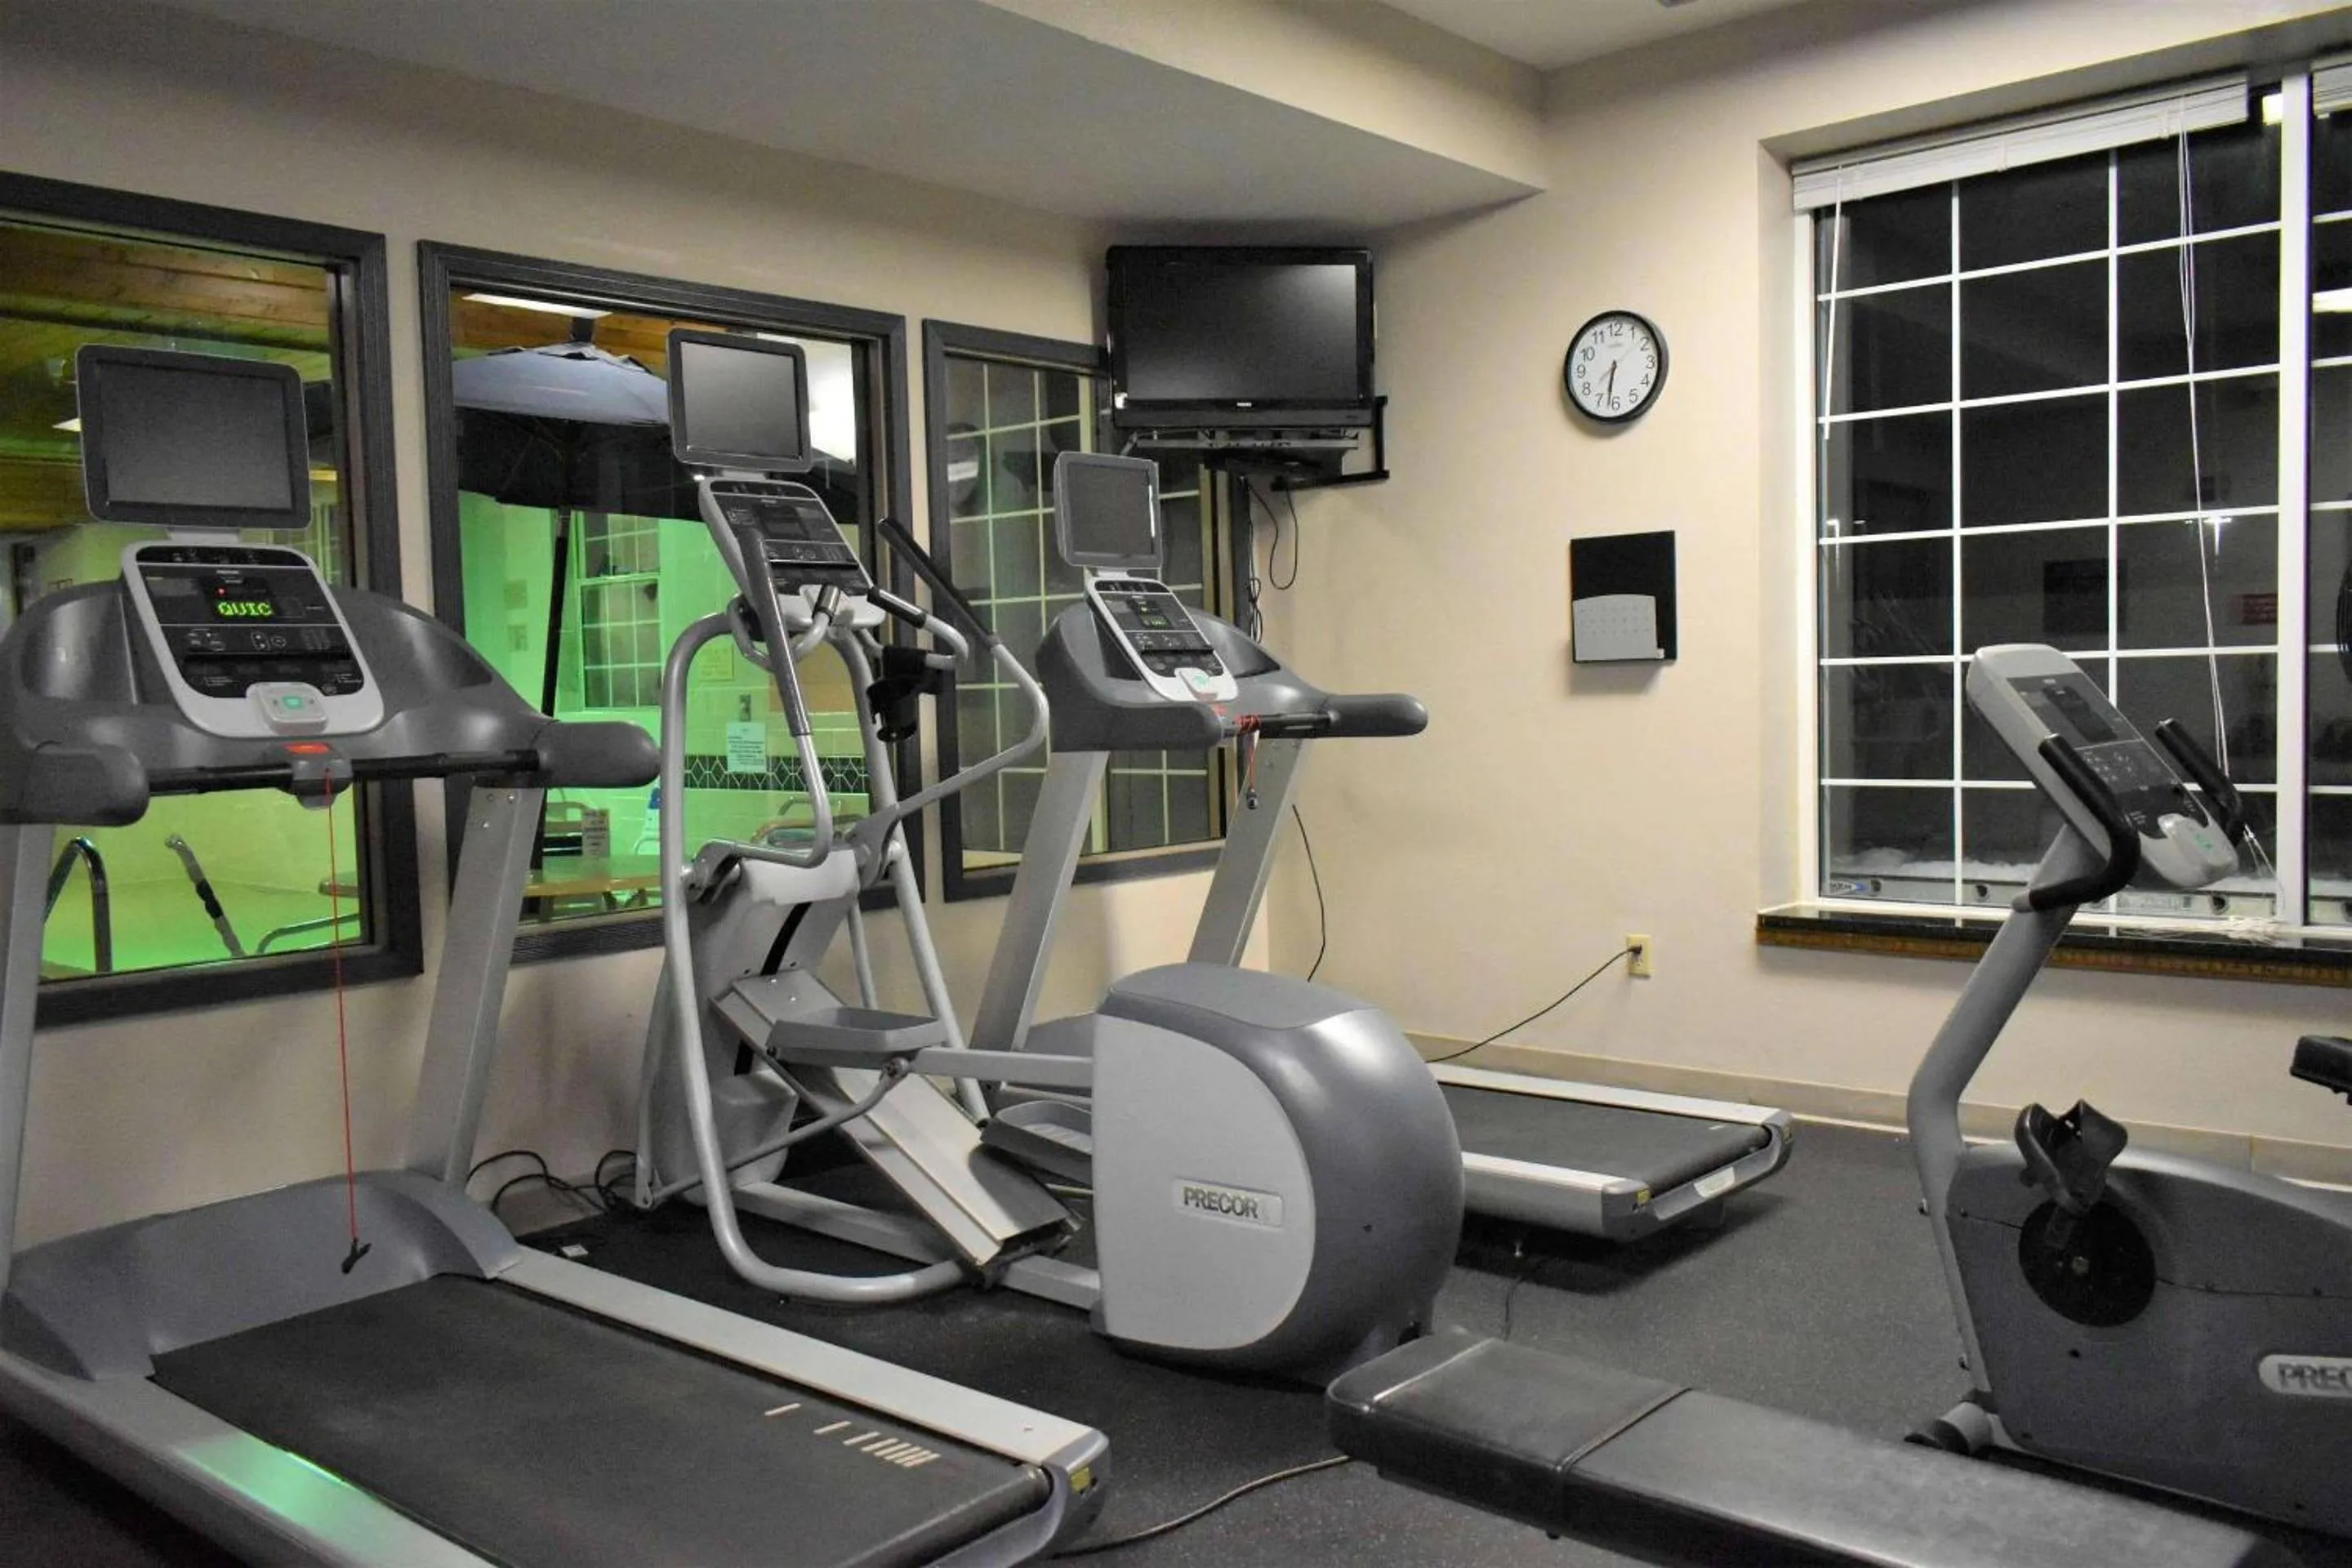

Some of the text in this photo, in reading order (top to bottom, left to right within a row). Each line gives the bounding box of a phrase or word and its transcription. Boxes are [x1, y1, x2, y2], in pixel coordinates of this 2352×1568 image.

[1592, 329, 1605, 344] 11
[1607, 322, 1624, 337] 12
[1627, 326, 1635, 340] 1
[1640, 336, 1650, 352] 2
[1580, 345, 1595, 361] 10
[1645, 354, 1655, 369] 3
[1576, 363, 1586, 378] 9
[1640, 373, 1650, 387] 4
[1582, 381, 1592, 396] 8
[1628, 388, 1638, 403] 5
[1594, 392, 1604, 408] 7
[1611, 396, 1620, 411] 6
[217, 600, 274, 617] QUIC
[1183, 1186, 1258, 1218] PRECOR
